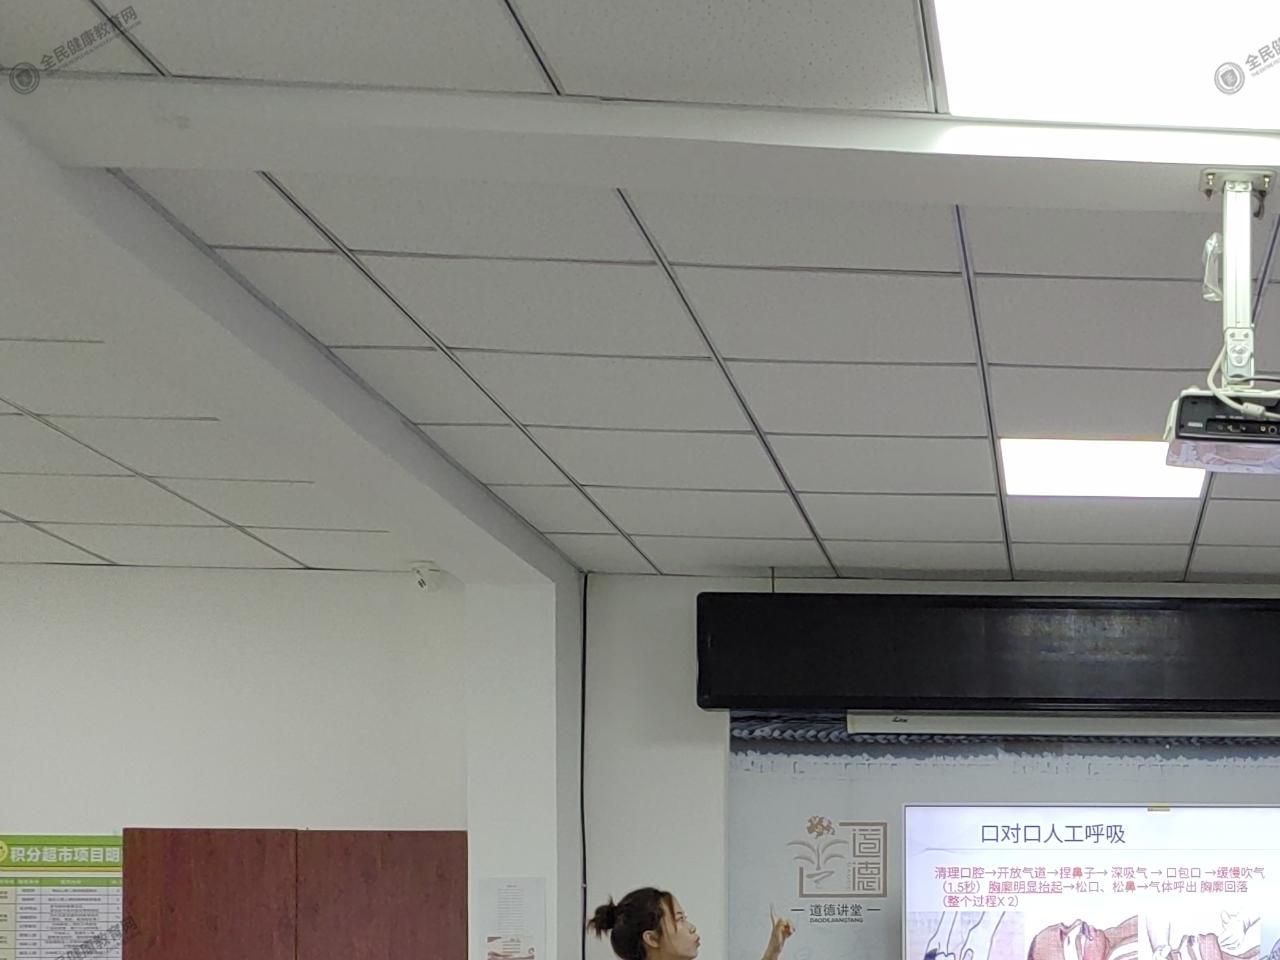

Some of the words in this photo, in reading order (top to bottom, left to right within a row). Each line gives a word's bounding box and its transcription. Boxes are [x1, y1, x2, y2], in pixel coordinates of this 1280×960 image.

[981, 823, 1126, 844] 口对口人工呼吸
[10, 846, 120, 863] 积分超市项目明
[935, 866, 985, 879] 清理口腔
[997, 866, 1046, 879] 开放气道
[1060, 866, 1097, 879] 捏鼻子
[1111, 866, 1148, 879] 深吸气
[1166, 867, 1201, 879] 口包口
[1217, 866, 1266, 879] 缓慢吹气
[810, 903, 863, 917] 道德讲堂
